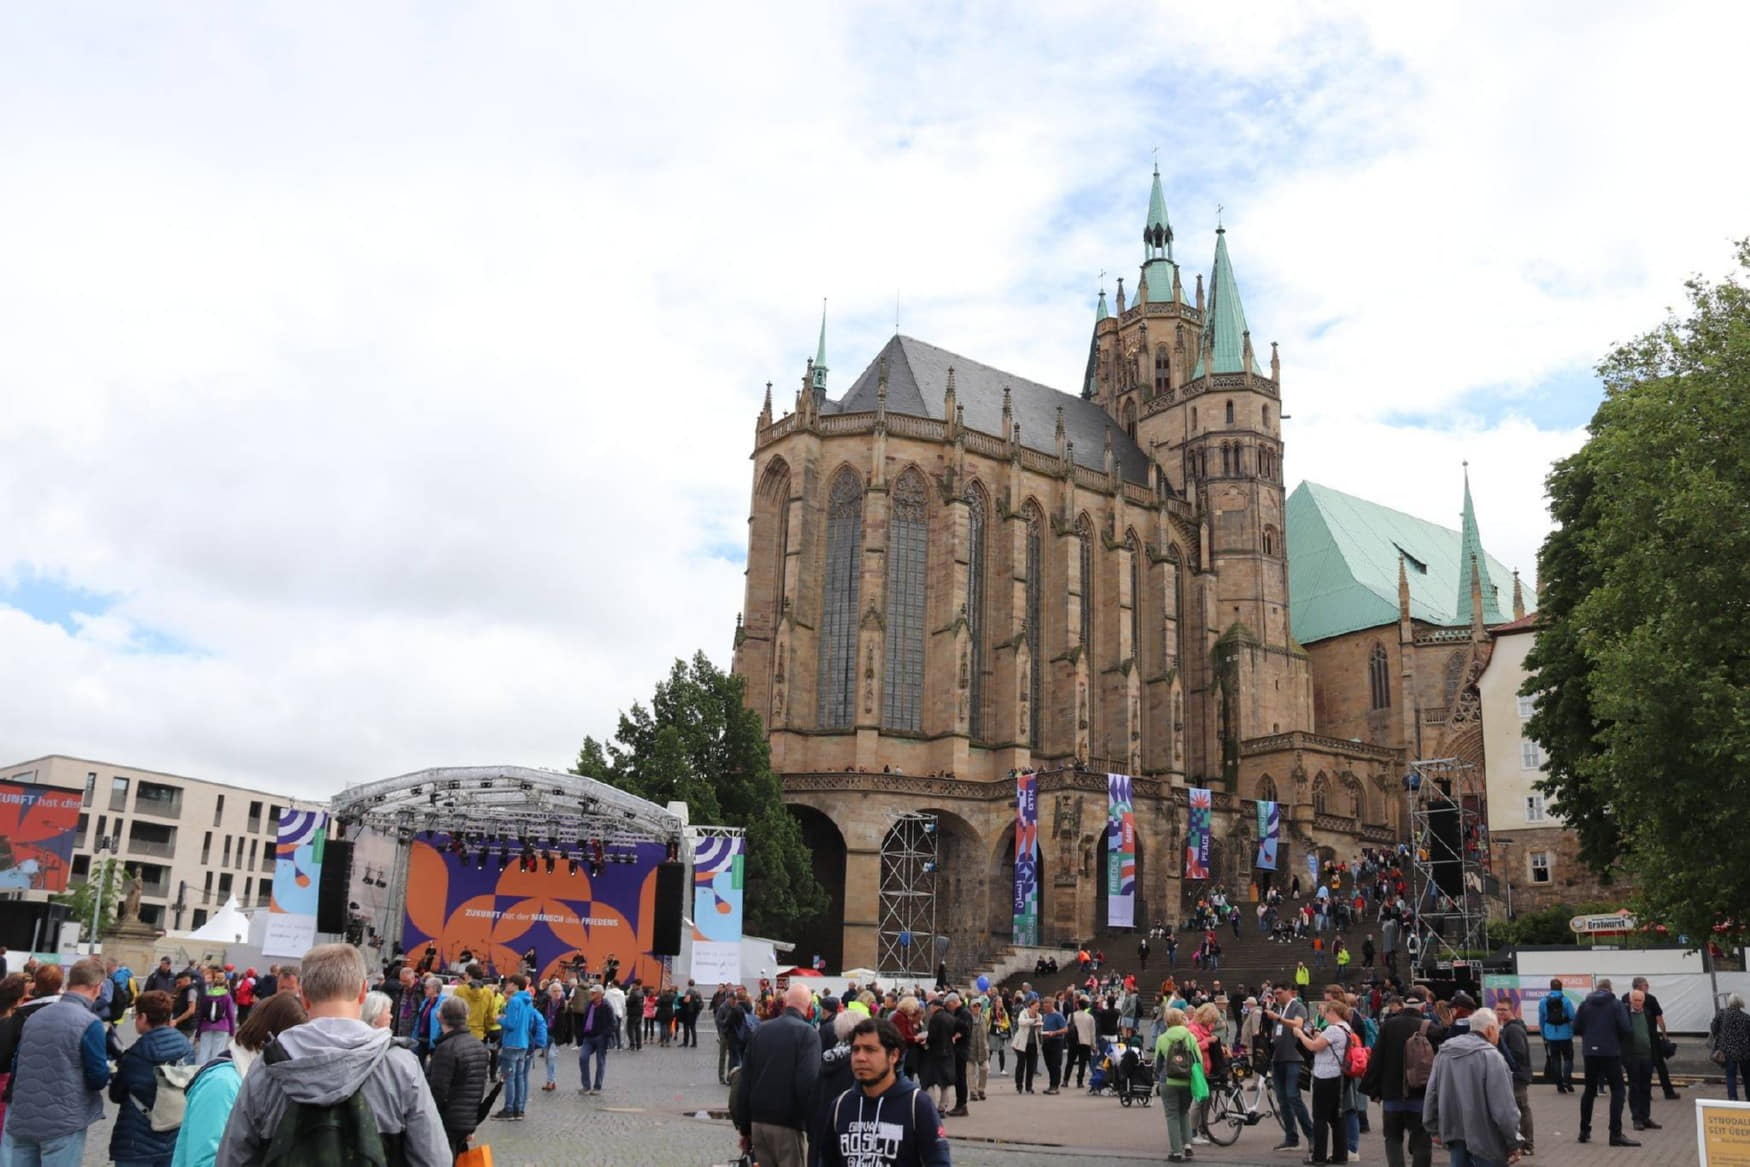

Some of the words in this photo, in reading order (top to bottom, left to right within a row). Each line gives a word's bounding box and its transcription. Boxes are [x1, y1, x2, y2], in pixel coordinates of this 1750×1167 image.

[1201, 834, 1209, 862] PEACE
[1111, 855, 1120, 892] FRIEDEN
[465, 909, 501, 919] ZUKUNFT
[531, 913, 564, 922] MENSCH
[581, 917, 619, 927] FRIEDENS
